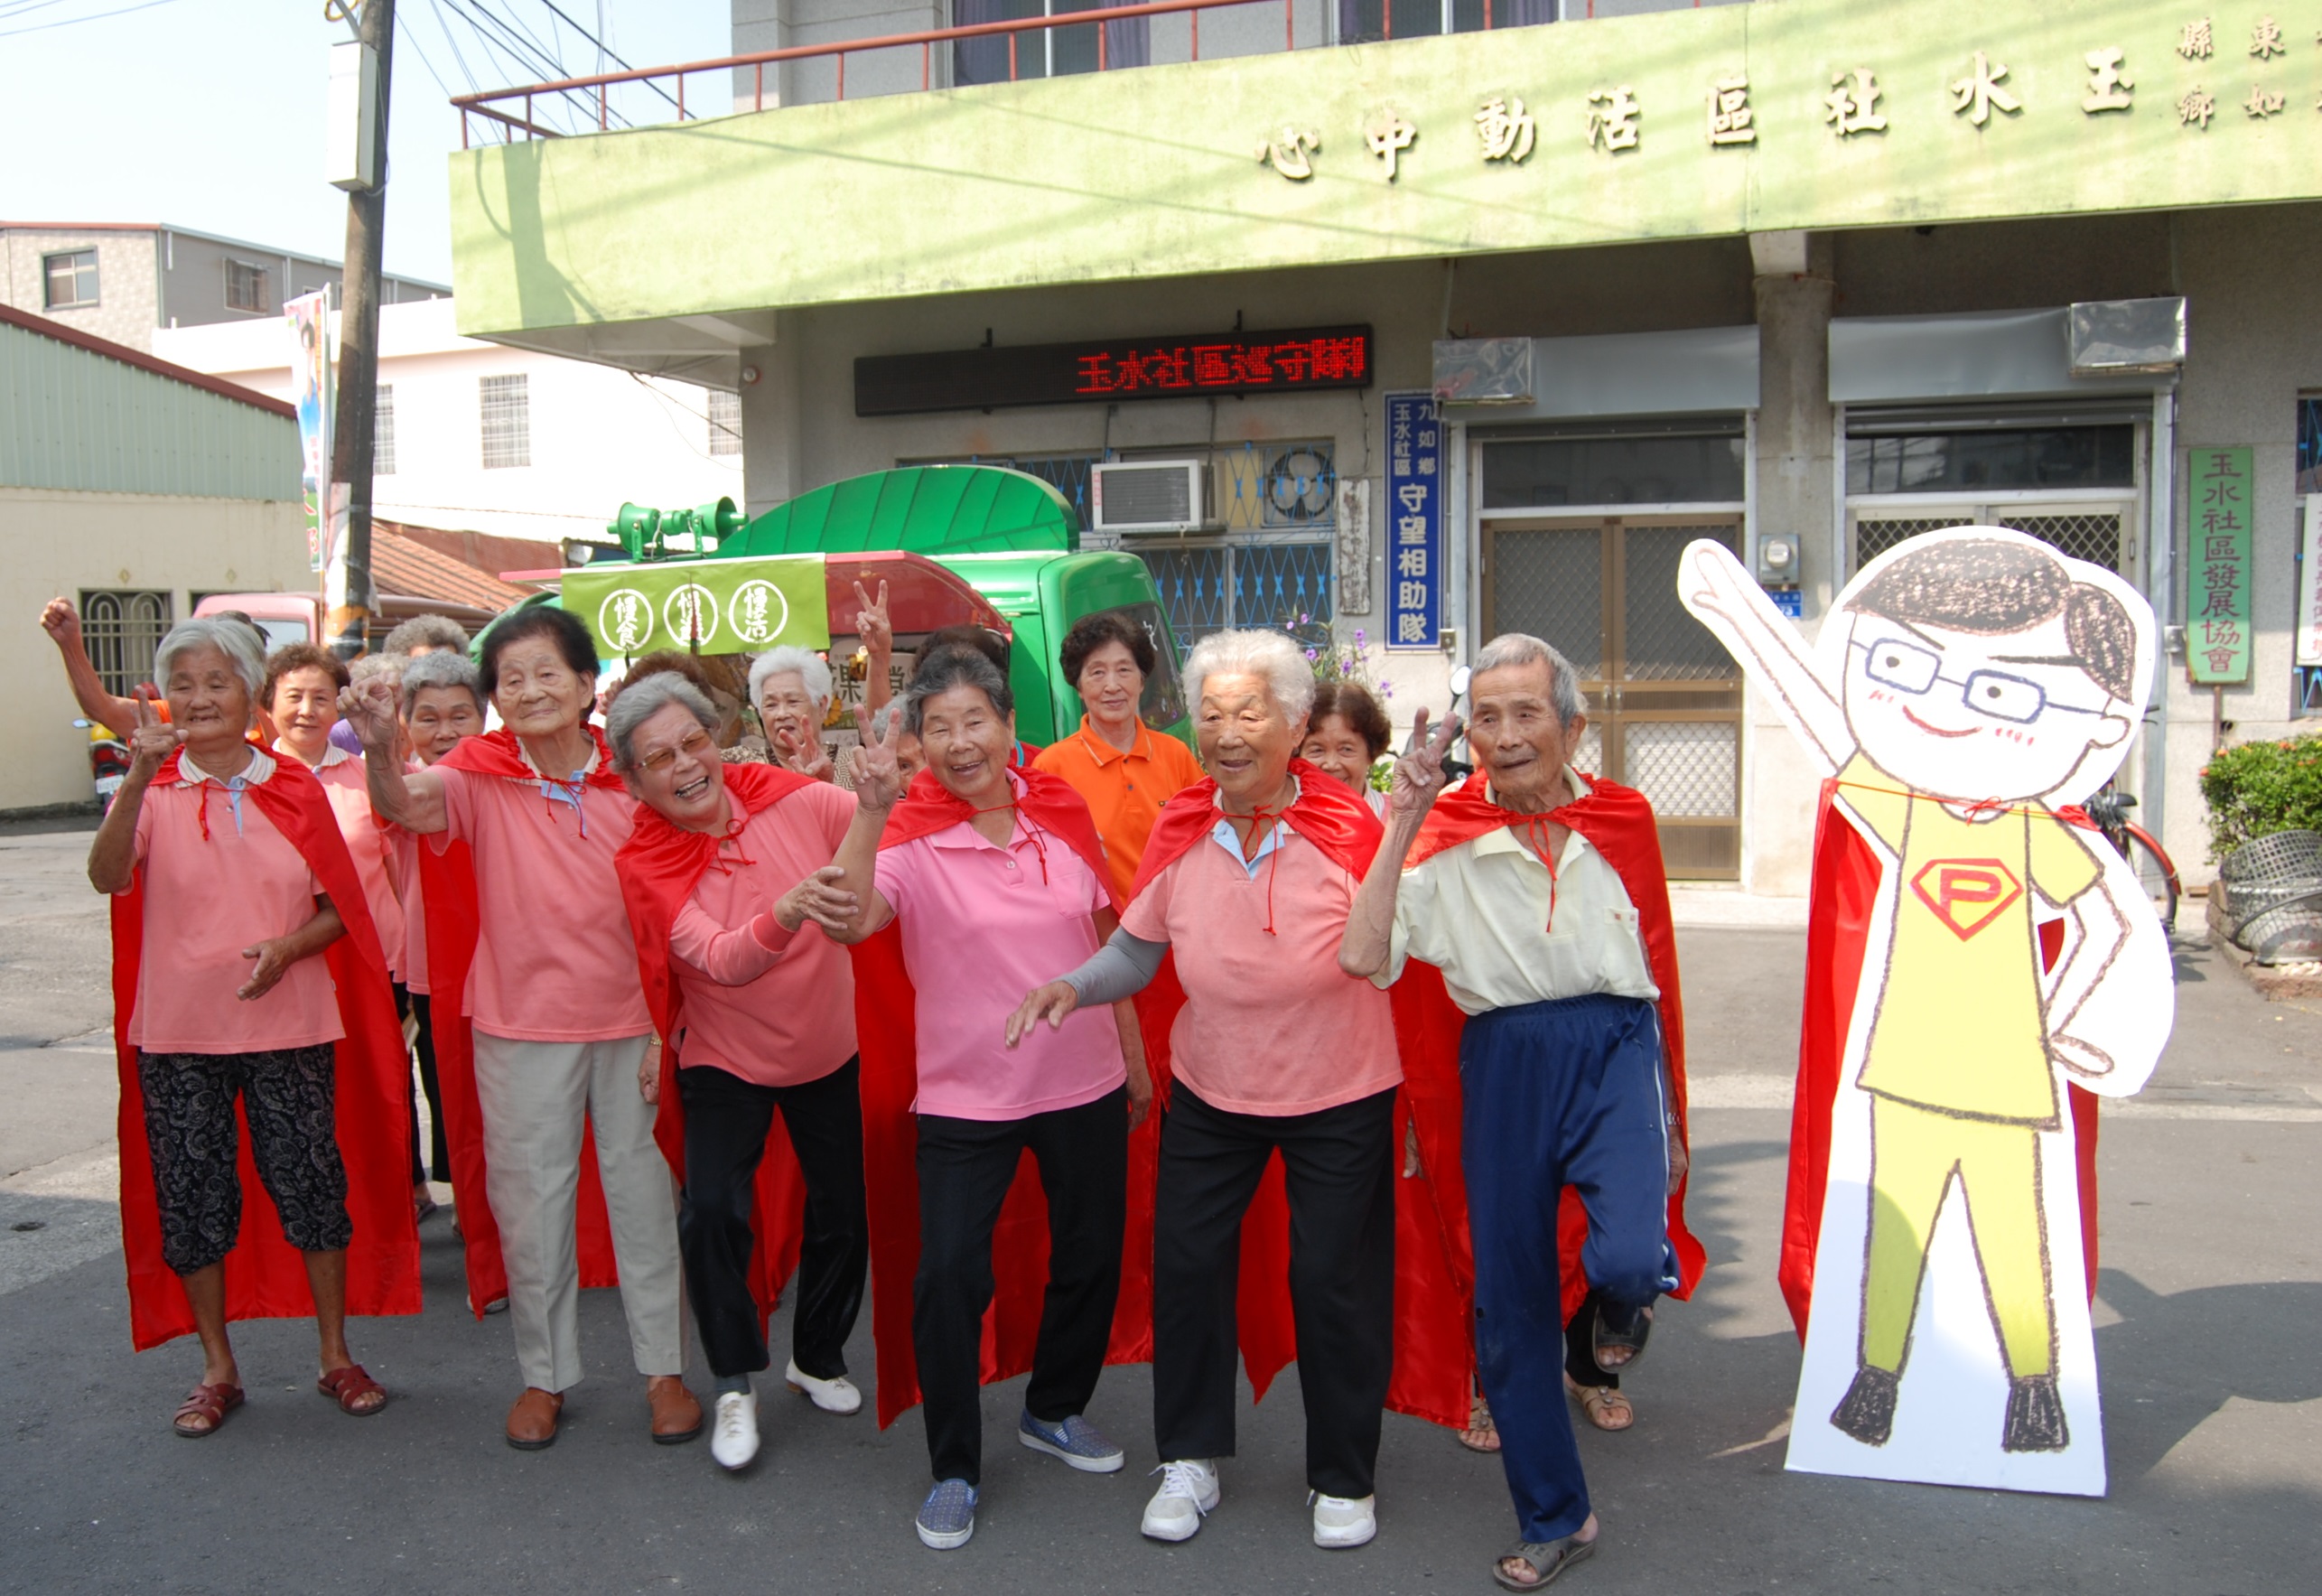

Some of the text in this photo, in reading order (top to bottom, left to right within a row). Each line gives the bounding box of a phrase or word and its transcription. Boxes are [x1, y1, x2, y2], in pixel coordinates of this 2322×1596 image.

[2176, 15, 2322, 61] 東縣
[2175, 84, 2322, 132] 如鄉
[1394, 404, 1412, 476] 玉水社區
[1417, 404, 1437, 476] 九如鄉
[1398, 483, 1428, 643] 守望相助隊
[2200, 453, 2243, 673] 玉水社區發展協會
[613, 595, 639, 648] 慢食
[743, 586, 769, 639] 慢活
[1939, 868, 2003, 921] P
